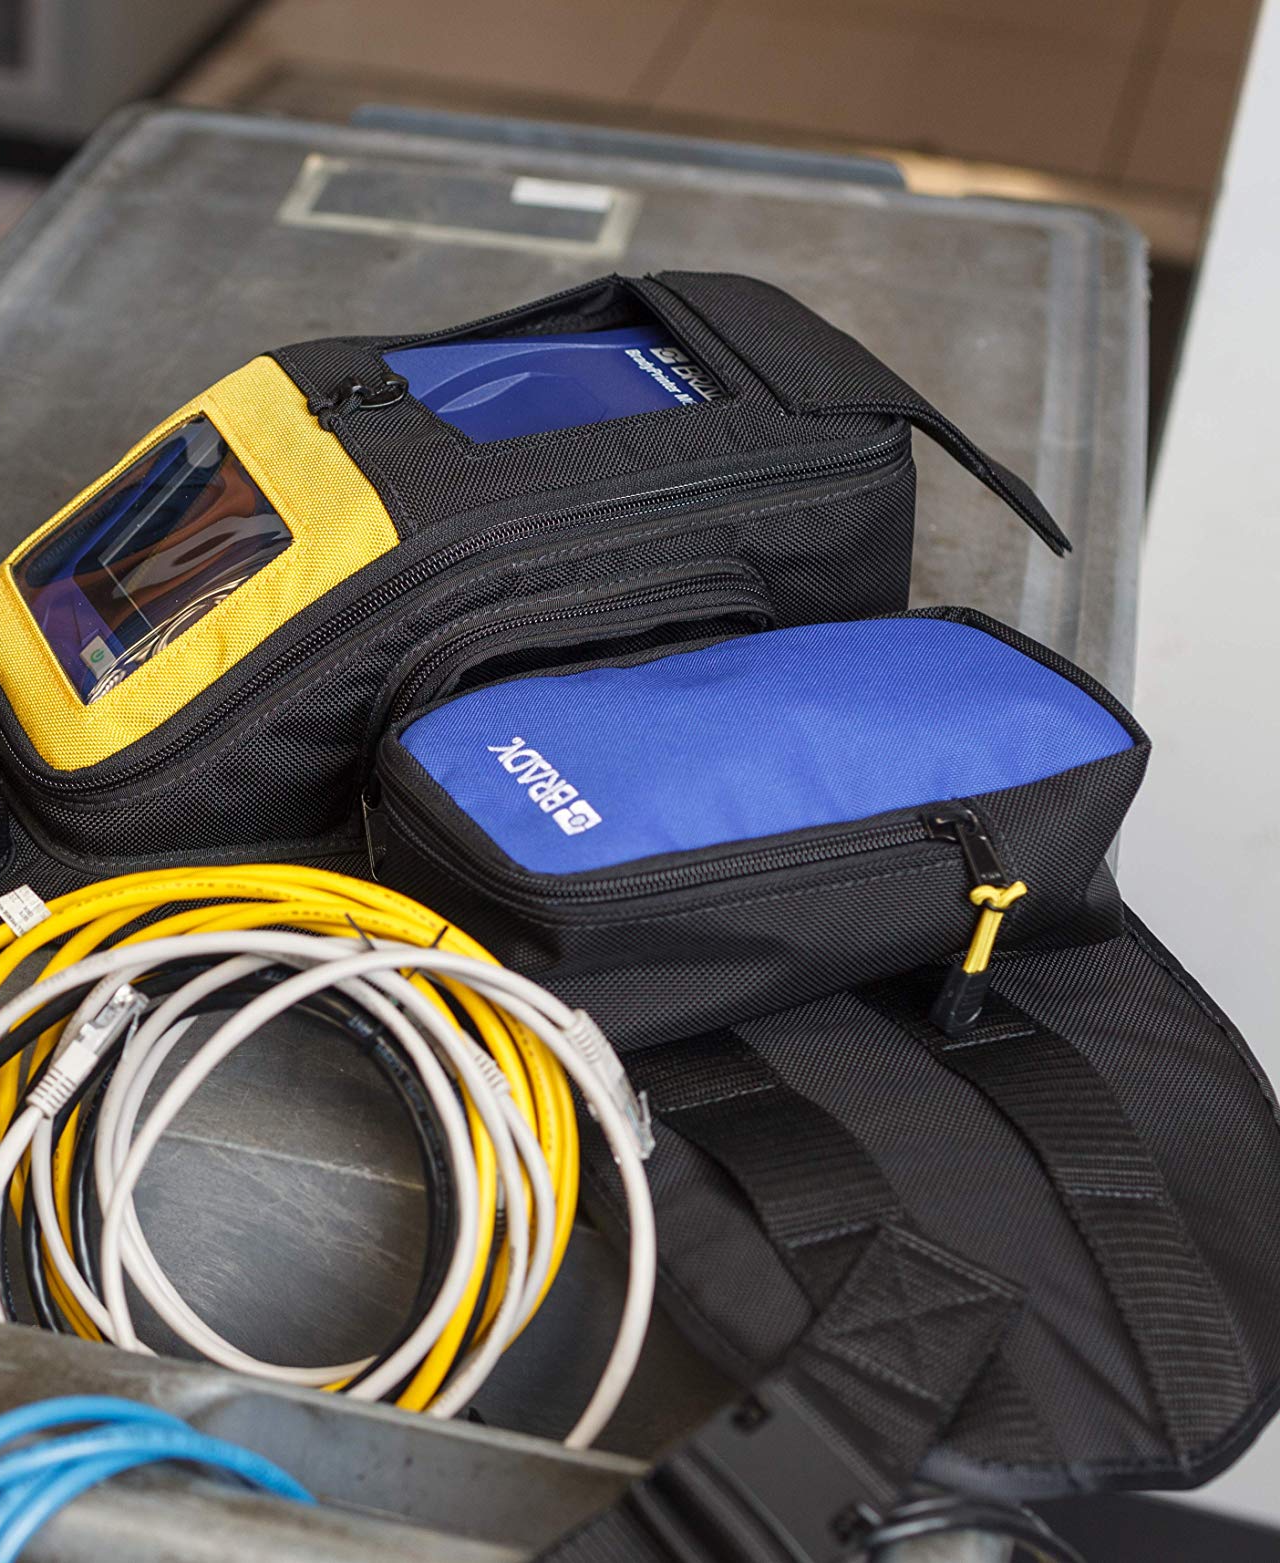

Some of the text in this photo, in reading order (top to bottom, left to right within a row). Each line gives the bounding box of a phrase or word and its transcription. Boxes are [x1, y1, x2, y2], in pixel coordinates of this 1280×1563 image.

[624, 348, 682, 393] BradyPrinter
[670, 364, 724, 402] BRA
[486, 736, 579, 814] BRADY
